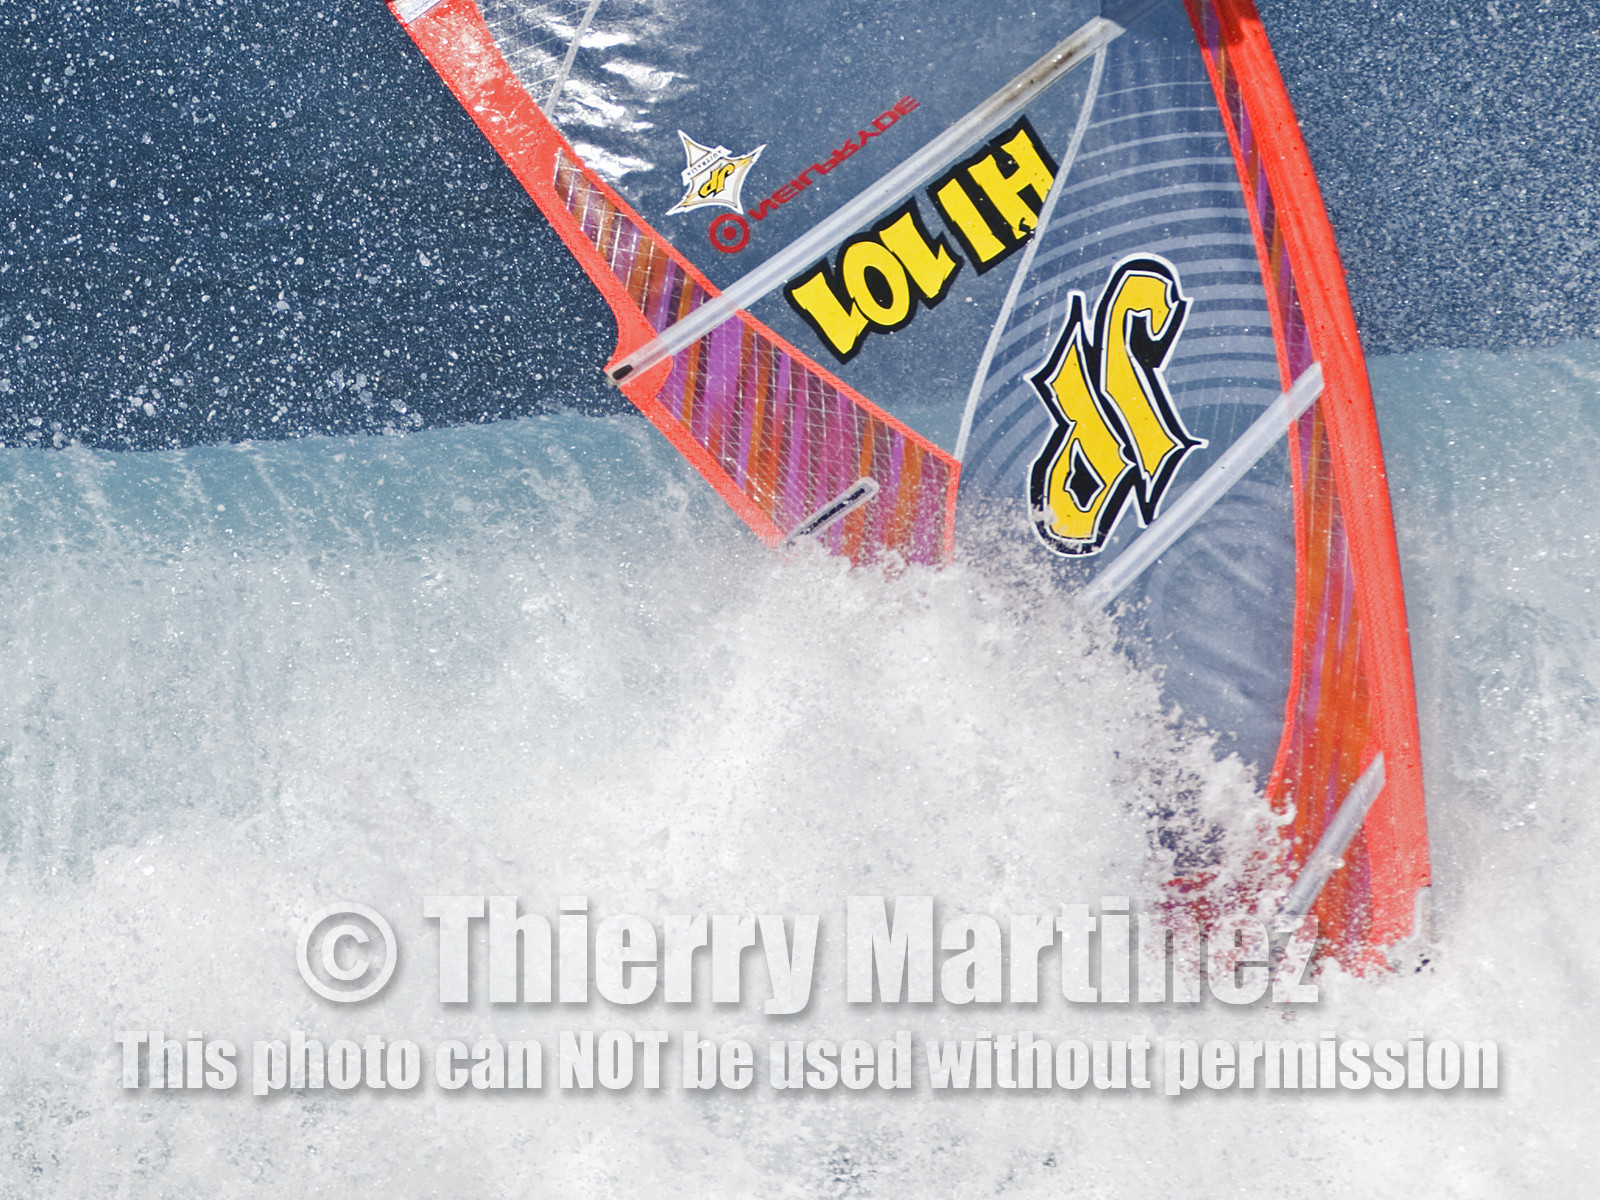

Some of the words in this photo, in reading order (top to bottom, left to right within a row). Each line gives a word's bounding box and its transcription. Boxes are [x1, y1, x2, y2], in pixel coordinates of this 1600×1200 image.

[698, 162, 735, 198] JP
[931, 123, 1057, 268] HI
[787, 207, 961, 358] 101
